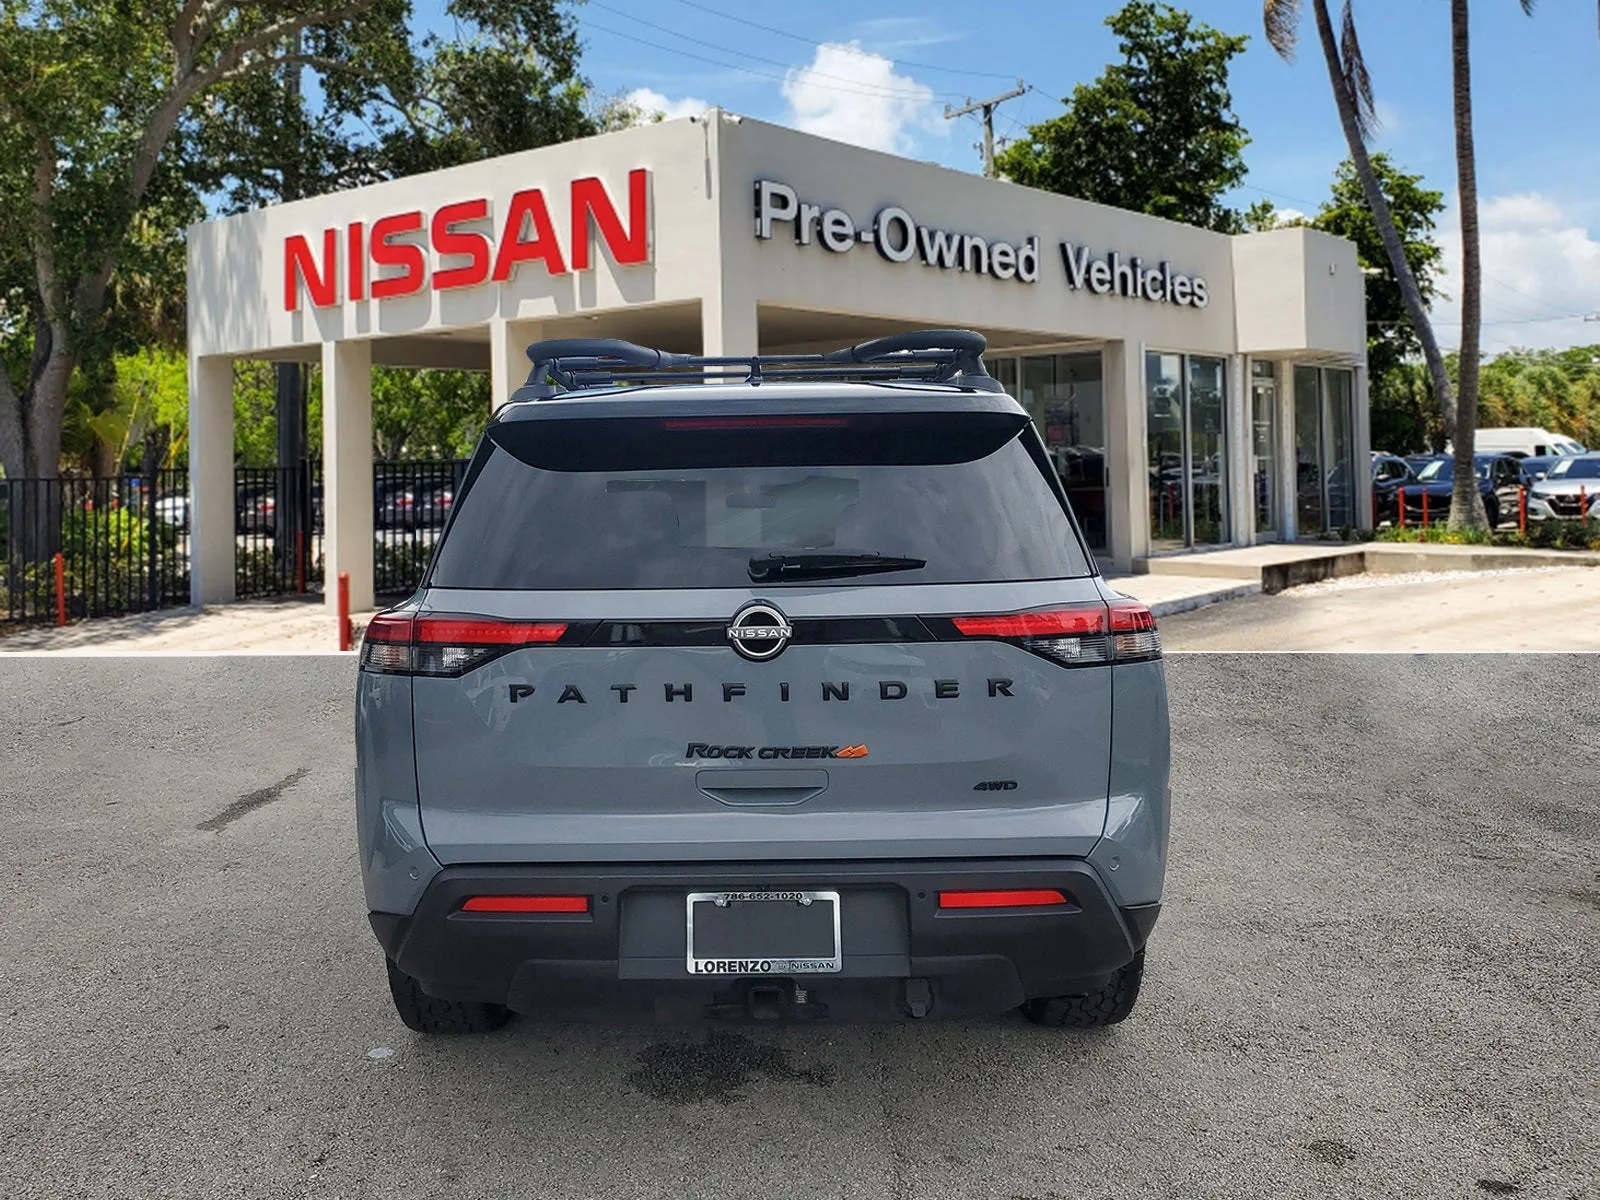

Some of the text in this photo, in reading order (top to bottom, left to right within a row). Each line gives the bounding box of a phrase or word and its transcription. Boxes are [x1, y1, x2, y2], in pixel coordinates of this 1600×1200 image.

[284, 168, 647, 312] NISSAN
[754, 180, 1209, 308] Pre-Owned Vehicles
[728, 628, 790, 638] NISSAN
[508, 677, 1015, 703] PATHFINDER
[973, 780, 1018, 792] 4WD
[724, 892, 803, 900] 786-652-1020
[694, 960, 835, 973] LORENZO NISSAN
